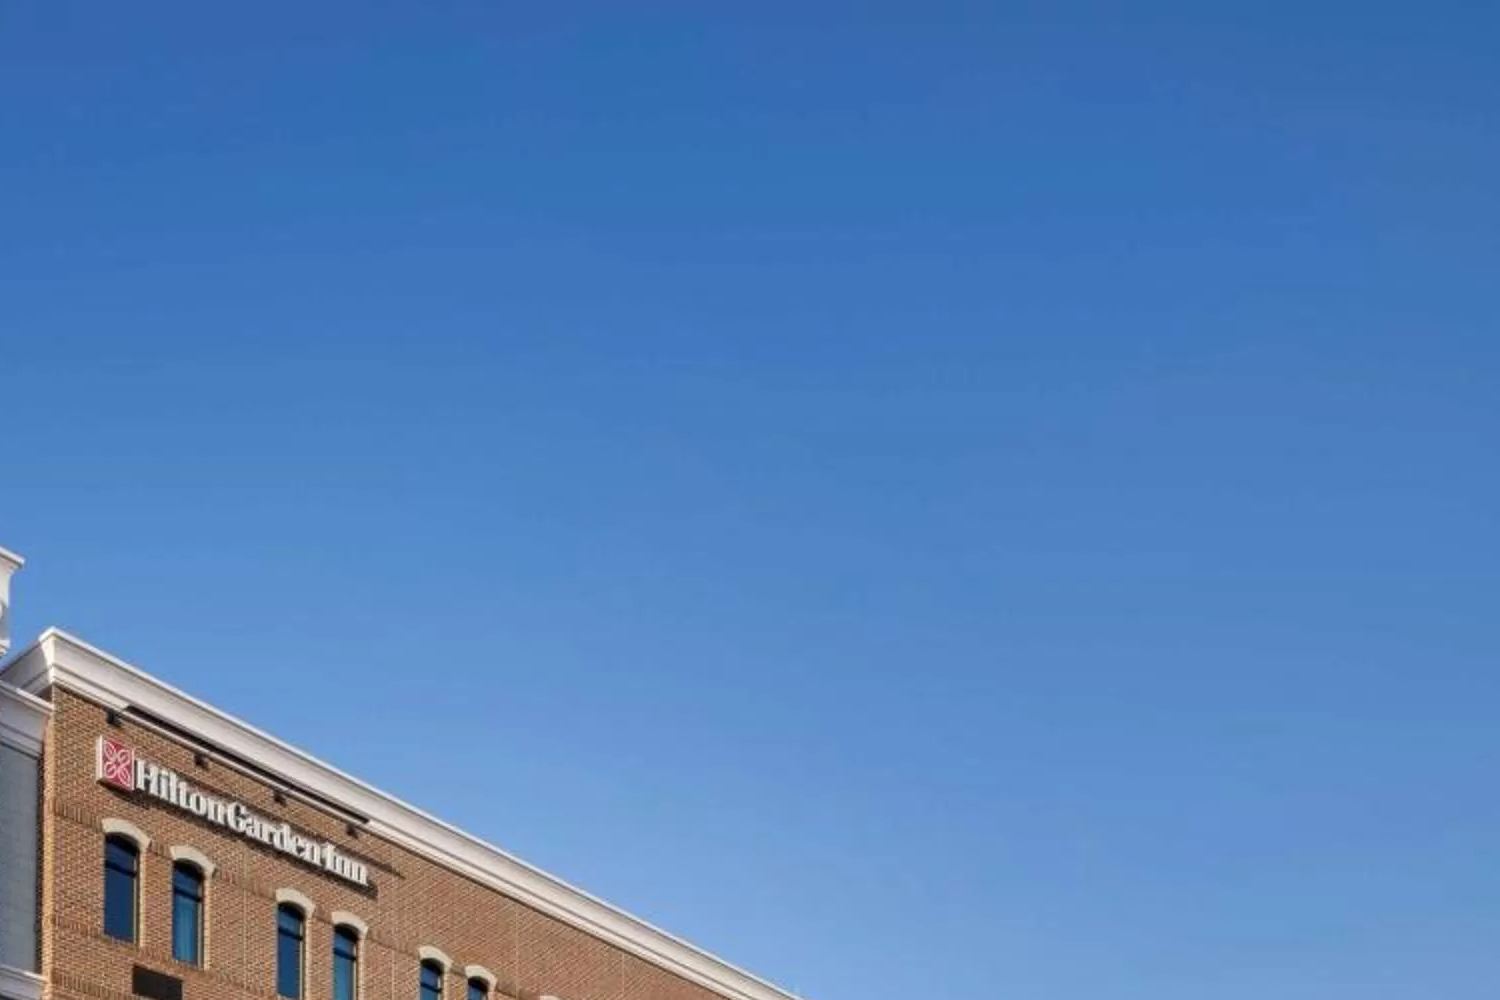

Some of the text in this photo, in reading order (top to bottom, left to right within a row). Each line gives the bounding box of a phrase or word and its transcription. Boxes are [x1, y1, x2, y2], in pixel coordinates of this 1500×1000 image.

[136, 760, 369, 887] Hilton Garden Inn
